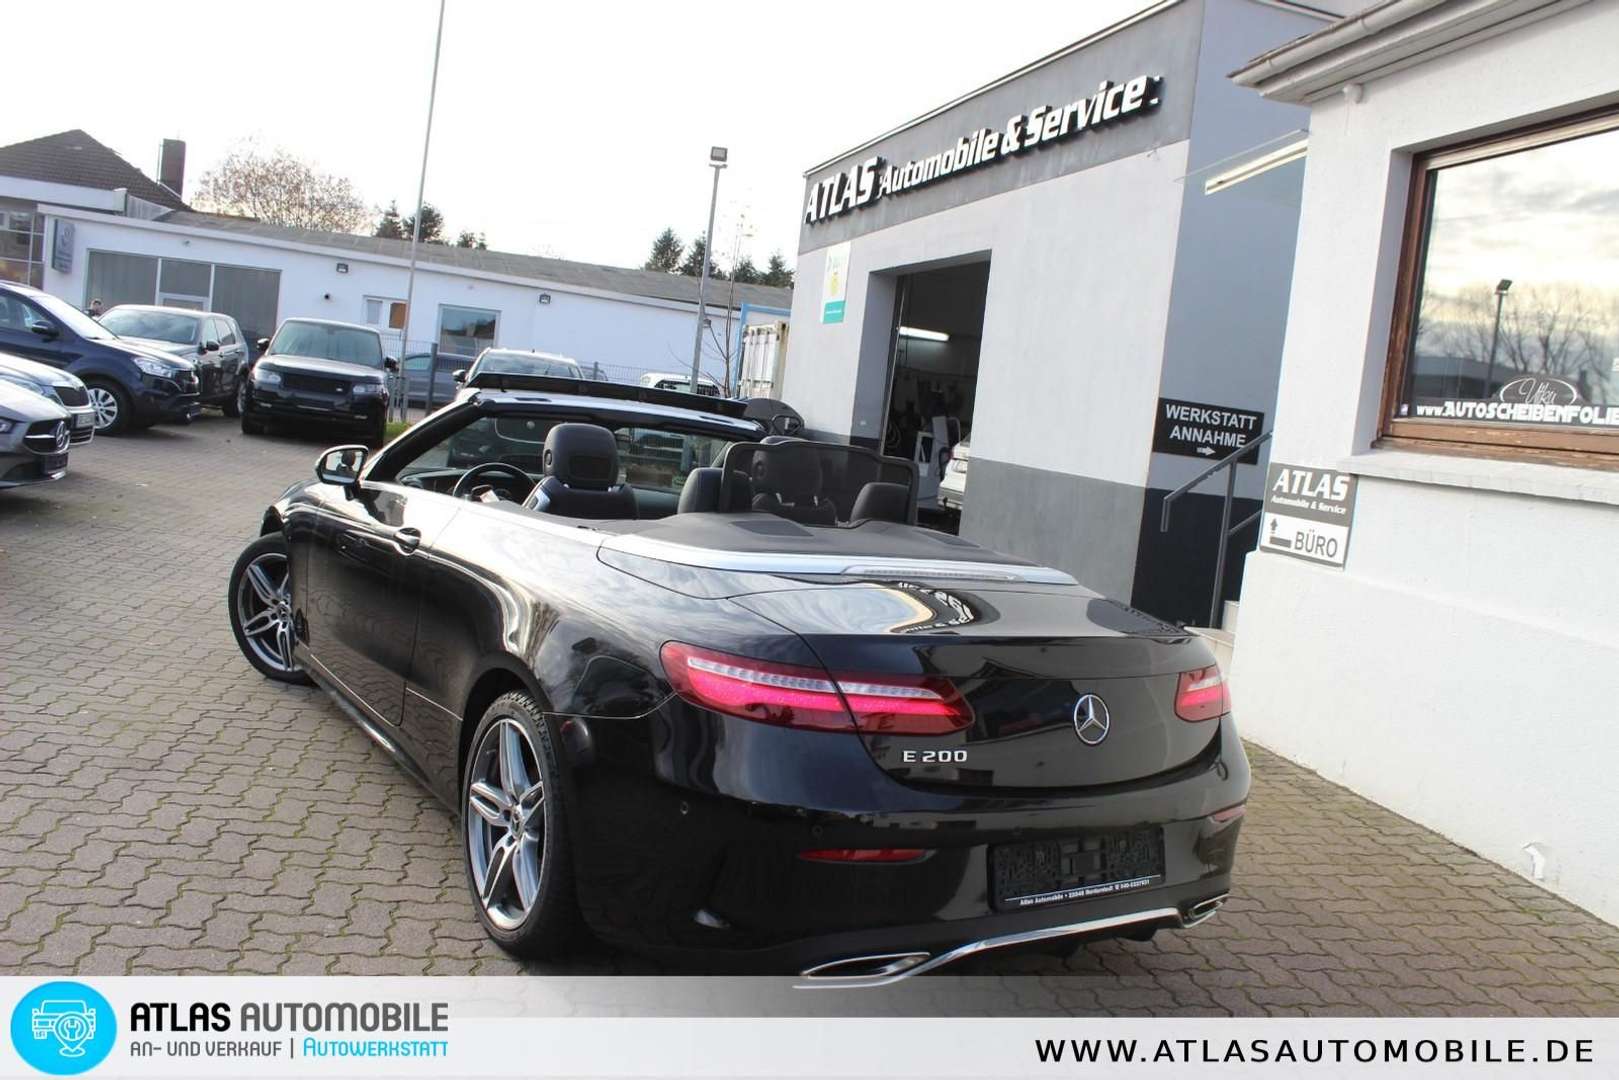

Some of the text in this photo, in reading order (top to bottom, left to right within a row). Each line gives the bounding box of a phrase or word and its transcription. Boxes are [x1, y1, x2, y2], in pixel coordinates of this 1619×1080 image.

[804, 157, 881, 224] ATLAS
[880, 129, 1000, 199] Automobile
[1000, 114, 1029, 155] &
[1165, 404, 1257, 430] WERKSTATT
[1169, 425, 1247, 448] ANNAHME
[1272, 468, 1350, 502] ATLAS
[1270, 495, 1347, 515] Automobile & Service
[1294, 529, 1338, 558] BÜRO
[903, 750, 968, 763] E 200
